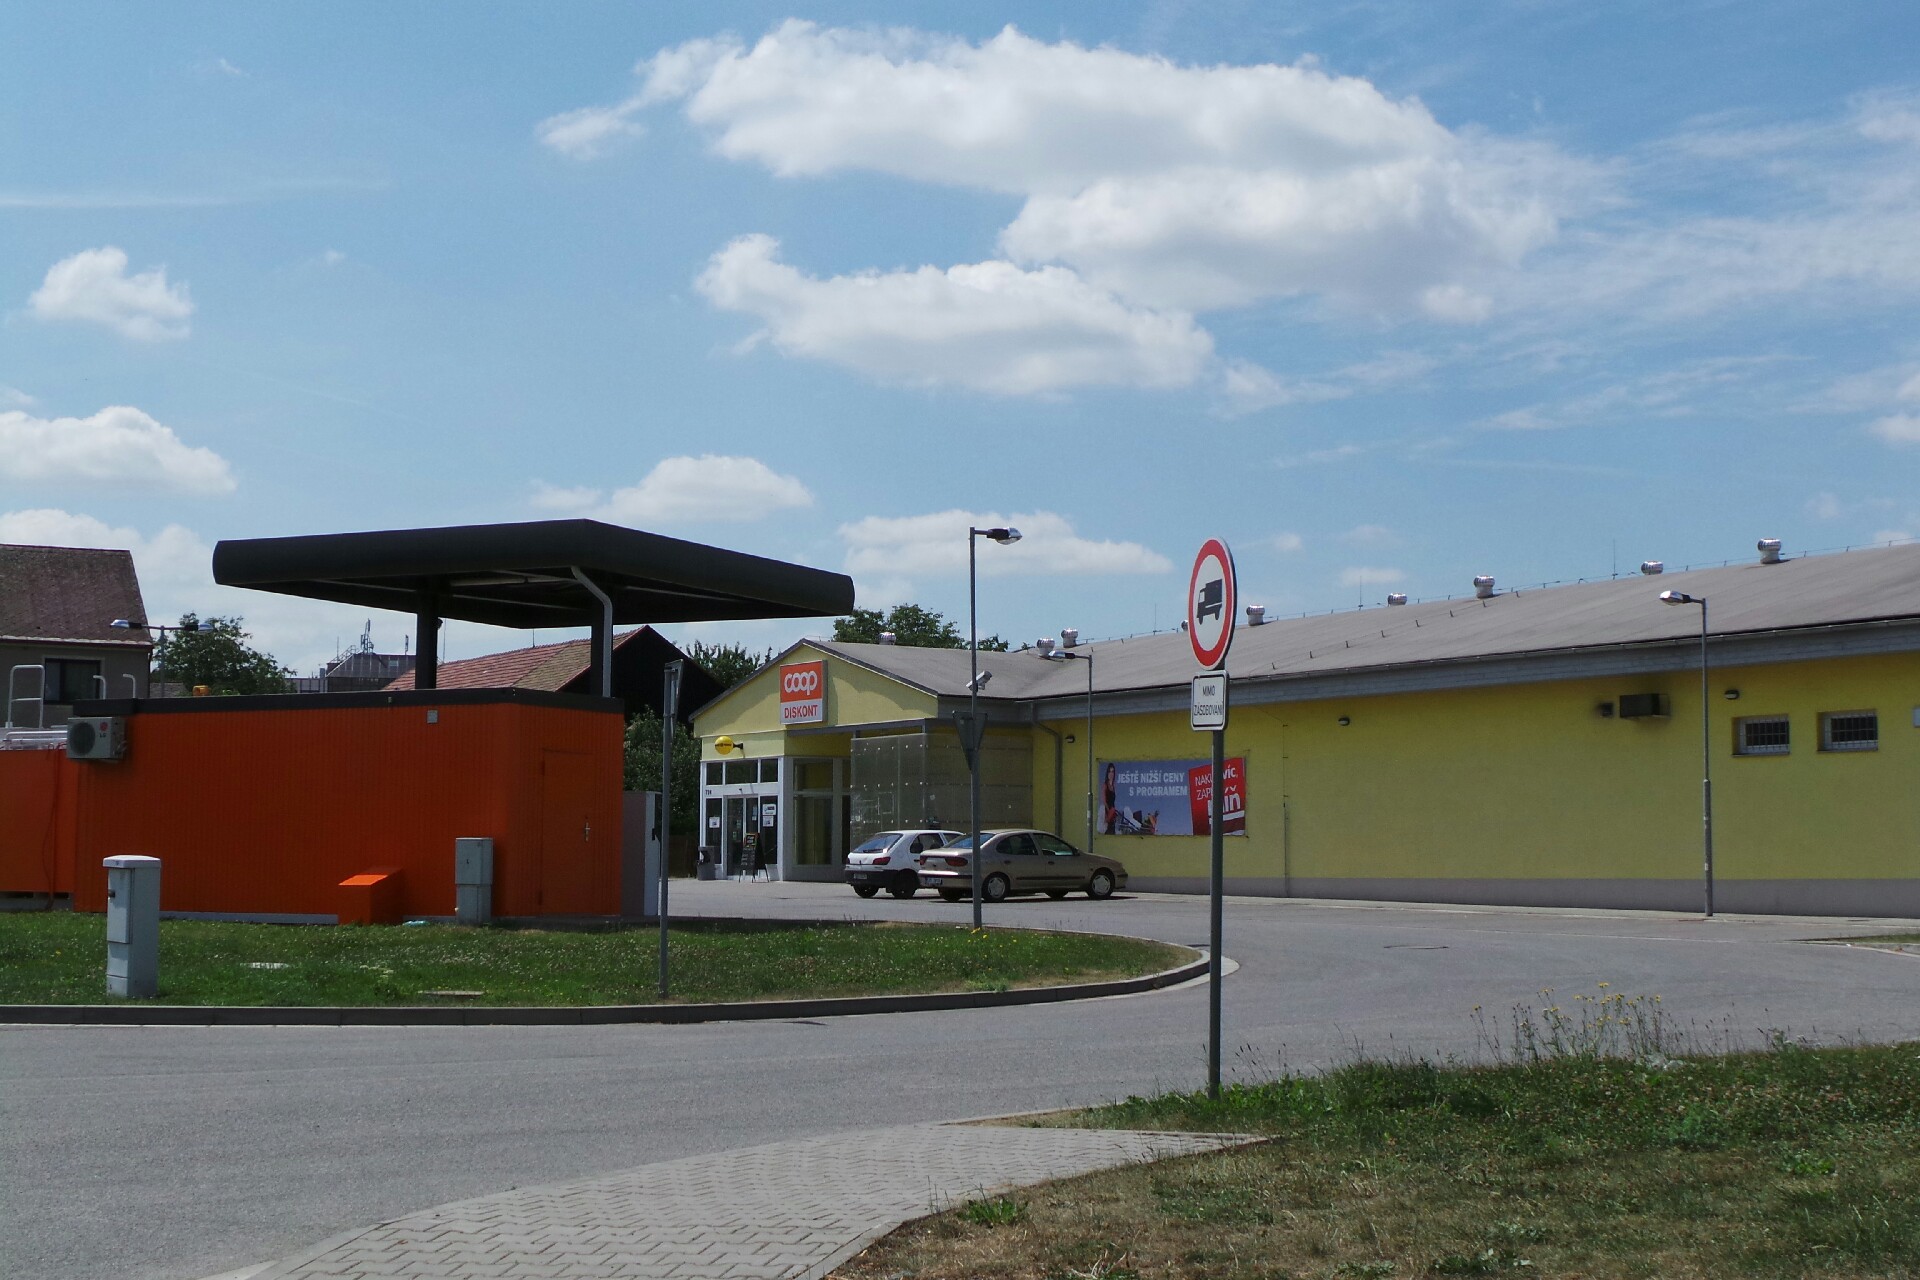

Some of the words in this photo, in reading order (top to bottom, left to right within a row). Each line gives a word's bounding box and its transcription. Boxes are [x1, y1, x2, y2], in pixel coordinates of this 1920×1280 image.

[784, 670, 818, 696] coop
[1203, 685, 1216, 696] MIMO
[784, 705, 818, 719] DISKONT
[1117, 770, 1139, 784] JEŠTĚ
[1140, 770, 1162, 783] NIŽŠÍ
[1163, 772, 1185, 783] CENY
[1129, 786, 1134, 797] S
[1136, 785, 1188, 797] PROGRAMEM
